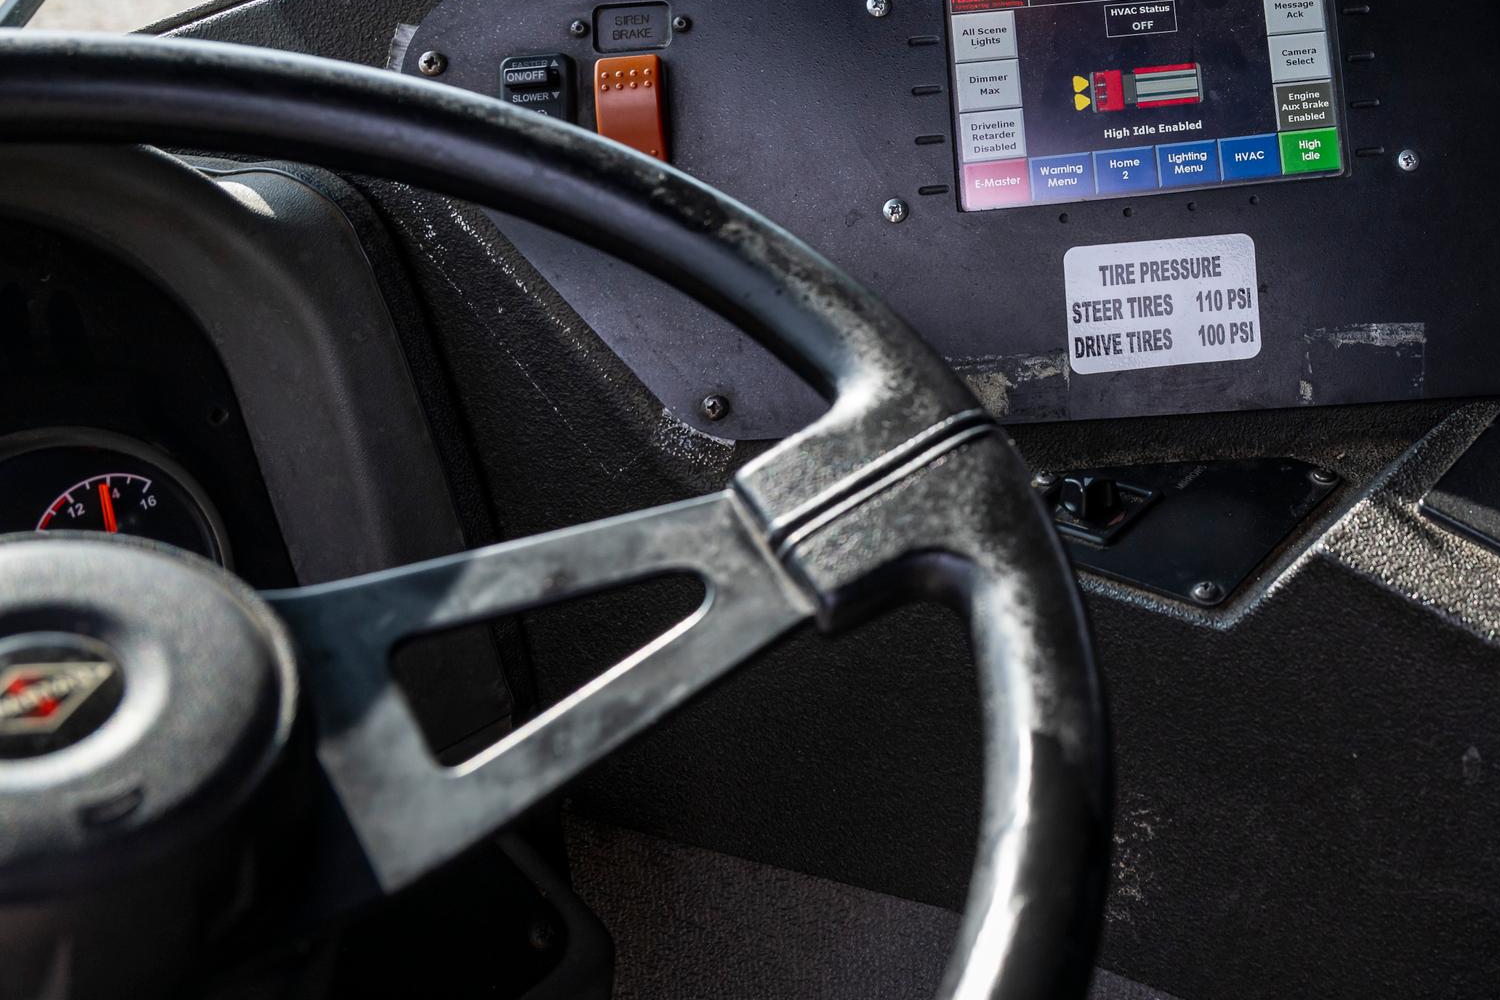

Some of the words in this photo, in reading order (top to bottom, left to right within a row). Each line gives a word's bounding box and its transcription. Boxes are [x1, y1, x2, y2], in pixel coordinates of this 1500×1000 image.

[1110, 7, 1138, 16] HVAC
[1139, 5, 1170, 14] Status
[1274, 0, 1314, 10] Message
[614, 14, 650, 26] SIREN
[1286, 11, 1304, 19] Ack
[1132, 20, 1154, 30] OFF
[612, 27, 653, 41] BRAKE
[962, 28, 975, 36] All
[977, 26, 1007, 35] Scene
[971, 37, 1001, 47] Lights
[1281, 47, 1317, 57] Camera
[1286, 57, 1315, 66] Select
[506, 70, 545, 82] ON/OFF
[969, 74, 1008, 84] Dimmer
[512, 92, 549, 103] SLOWER
[979, 88, 1000, 96] Max
[1288, 91, 1320, 101] Engine
[1281, 103, 1300, 112] Aux
[1302, 100, 1330, 109] Brake
[1288, 112, 1325, 123] Enabled
[971, 120, 1015, 131] Driveline
[1103, 128, 1130, 139] High
[1133, 125, 1156, 136] Idle
[1158, 120, 1203, 133] Enabled
[972, 131, 1015, 141] Retarder
[974, 142, 1017, 154] Disabled
[1298, 139, 1321, 150] High
[1167, 151, 1208, 163] Lighting
[1235, 151, 1265, 162] HVAC
[1302, 151, 1321, 161] Idle
[1109, 158, 1140, 169] Home
[1040, 163, 1084, 176] Warning
[1122, 170, 1129, 180] 2
[1174, 164, 1204, 175] Menu
[975, 177, 1021, 189] E-Master
[1047, 177, 1078, 187] Menu
[1099, 262, 1136, 287] TIRE
[1140, 256, 1222, 284] PRESSURE
[1072, 298, 1124, 324] STEER
[1127, 294, 1174, 319] TIRES
[1195, 289, 1224, 313] 110
[1227, 287, 1252, 311] PSI
[1074, 333, 1123, 359] DRIVE
[1126, 328, 1173, 354] TIRES
[1198, 323, 1226, 347] 100
[1229, 321, 1255, 345] PSI
[139, 495, 158, 511] 16
[67, 502, 86, 519] 12
